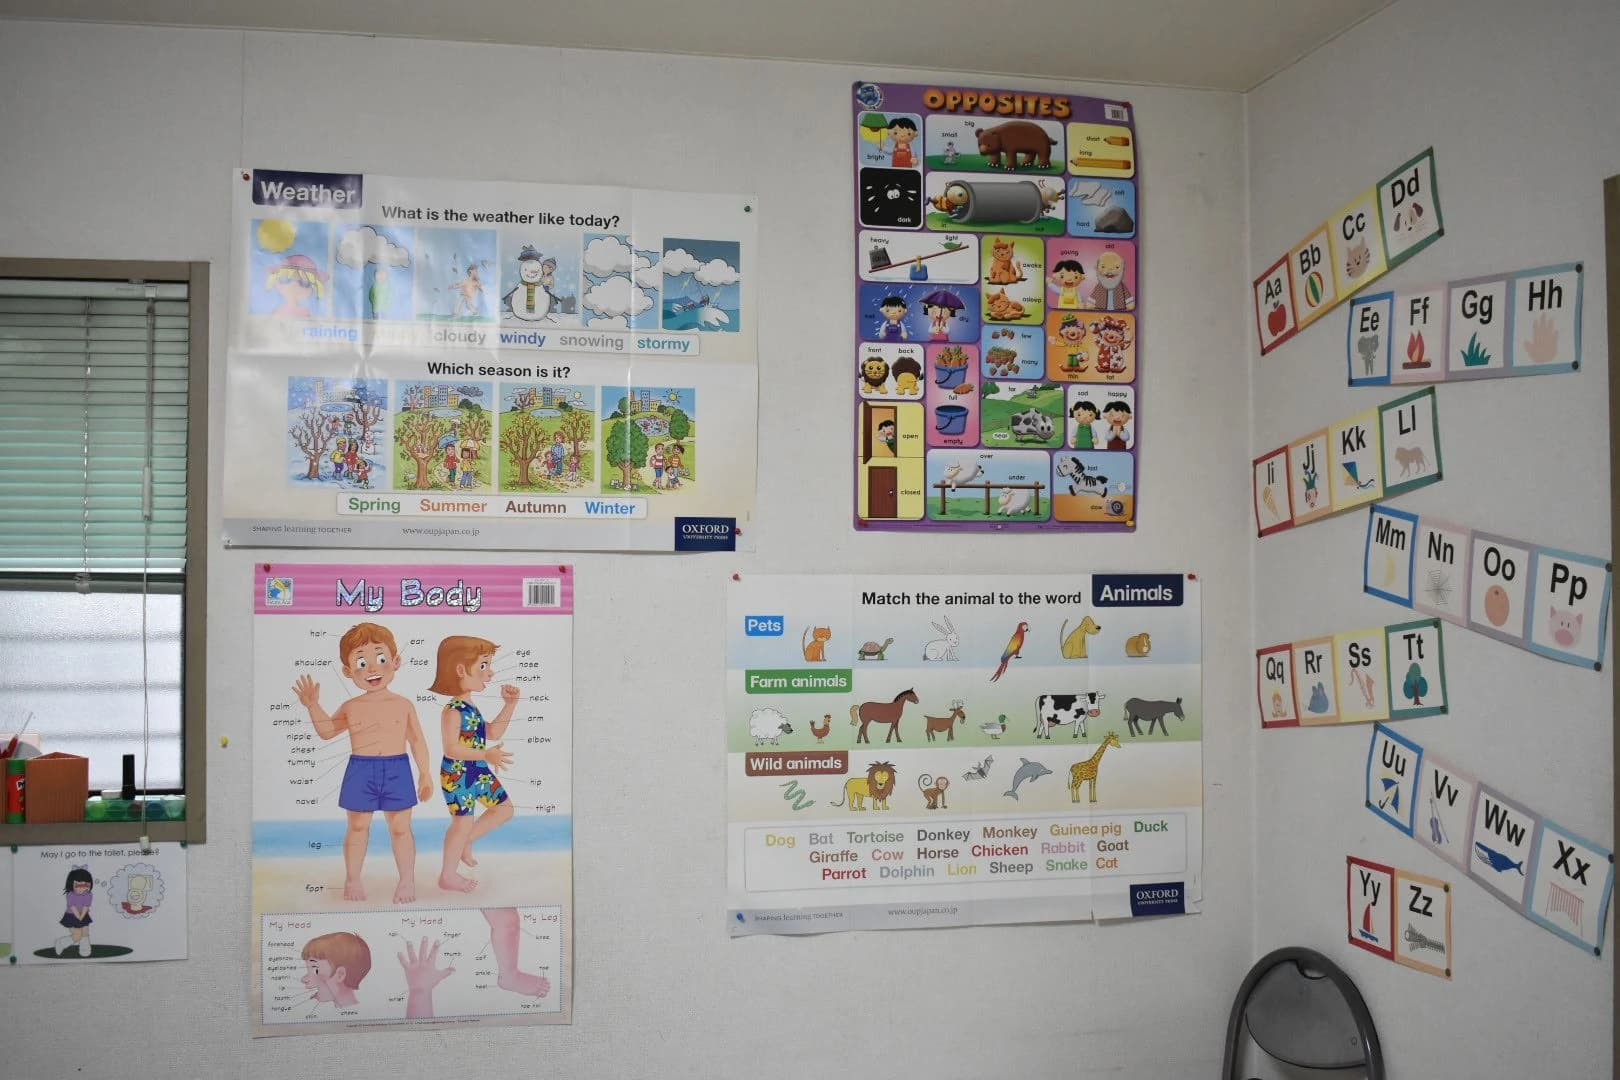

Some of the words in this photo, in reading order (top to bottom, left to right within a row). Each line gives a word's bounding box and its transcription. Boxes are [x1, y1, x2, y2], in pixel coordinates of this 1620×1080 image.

[923, 88, 1072, 118] OPPOSITES
[867, 153, 885, 161] bright
[261, 181, 356, 204] Weather
[382, 205, 422, 220] What
[426, 208, 439, 220] is
[444, 209, 468, 222] the
[473, 211, 535, 224] weather
[538, 213, 565, 225] like
[569, 214, 620, 228] today?
[1265, 277, 1283, 304] Aa
[1300, 244, 1321, 275] Bb
[1342, 212, 1366, 240] Cc
[1391, 168, 1420, 208] Dd
[1359, 306, 1380, 333] Ee
[1410, 296, 1430, 326] Ff
[1461, 289, 1493, 325] Gg
[1528, 278, 1563, 312] Hh
[434, 329, 486, 344] cloudy
[500, 331, 546, 347] windy
[559, 334, 624, 351] snowing
[637, 337, 690, 352] stormy
[427, 362, 474, 375] Which
[478, 366, 532, 377] season
[536, 365, 548, 378] is
[553, 366, 571, 378] it?
[1302, 443, 1316, 474] Jj
[1342, 425, 1366, 455] Kk
[1398, 404, 1417, 436] Ll
[349, 497, 400, 514] Spring
[420, 499, 488, 513] Summer
[505, 501, 567, 514] Autumn
[585, 501, 636, 515] Winter
[284, 524, 317, 535] learning
[682, 524, 729, 534] OXFORD
[1375, 517, 1406, 550] Mm
[1428, 531, 1455, 565] Nn
[1484, 547, 1516, 581] Oo
[1550, 562, 1588, 606] Pp
[335, 578, 384, 612] My
[400, 578, 482, 612] Body
[862, 592, 911, 605] Match
[915, 592, 940, 605] the
[944, 592, 995, 605] animal
[999, 593, 1014, 605] to
[1018, 592, 1042, 604] the
[1045, 591, 1082, 604] word
[1100, 585, 1173, 601] Animals
[748, 619, 782, 632] Pets
[310, 629, 327, 638] hair
[516, 650, 531, 658] eye
[1266, 657, 1285, 684] Qq
[1304, 650, 1323, 675] Rr
[1349, 642, 1372, 668] Ss
[1403, 633, 1425, 661] Tt
[294, 659, 333, 667] shoulder
[410, 657, 429, 666] face
[750, 675, 787, 688] Farm
[791, 674, 847, 688] animals
[416, 694, 437, 702] back
[270, 702, 290, 711] palm
[288, 759, 316, 768] tummy
[750, 757, 783, 771] Wild
[786, 756, 842, 770] animals
[290, 777, 313, 785] waist
[1382, 740, 1407, 777] Uu
[1434, 769, 1459, 807] Vv
[1485, 799, 1526, 847] Ww
[1553, 840, 1591, 886] Xx
[765, 834, 796, 848] Dog
[809, 833, 834, 845] Bat
[847, 831, 905, 844] Tortoise
[917, 829, 970, 843] Donkey
[983, 826, 1038, 840] Monkey
[1050, 824, 1098, 837] Guinea
[1101, 823, 1122, 837] pig
[1134, 820, 1168, 833] Duck
[309, 840, 322, 850] leg
[809, 850, 858, 863] Giraffe
[871, 849, 904, 861] Cow
[917, 847, 959, 860] Horse
[971, 844, 1029, 858] Chicken
[1041, 842, 1086, 855] Rabbit
[1097, 839, 1129, 852] Goat
[40, 851, 59, 859] May
[78, 850, 86, 858] to
[89, 849, 102, 857] the
[822, 867, 867, 880] Parrot
[880, 865, 935, 880] Dolphin
[947, 863, 977, 876] Lion
[989, 861, 1034, 876] Sheep
[1046, 859, 1088, 872] Snake
[1096, 857, 1118, 869] Cat
[305, 884, 324, 892] foot
[1136, 889, 1179, 900] OXFORD
[1360, 870, 1381, 906] Yy
[1408, 885, 1433, 917] Zz
[523, 914, 537, 923] My
